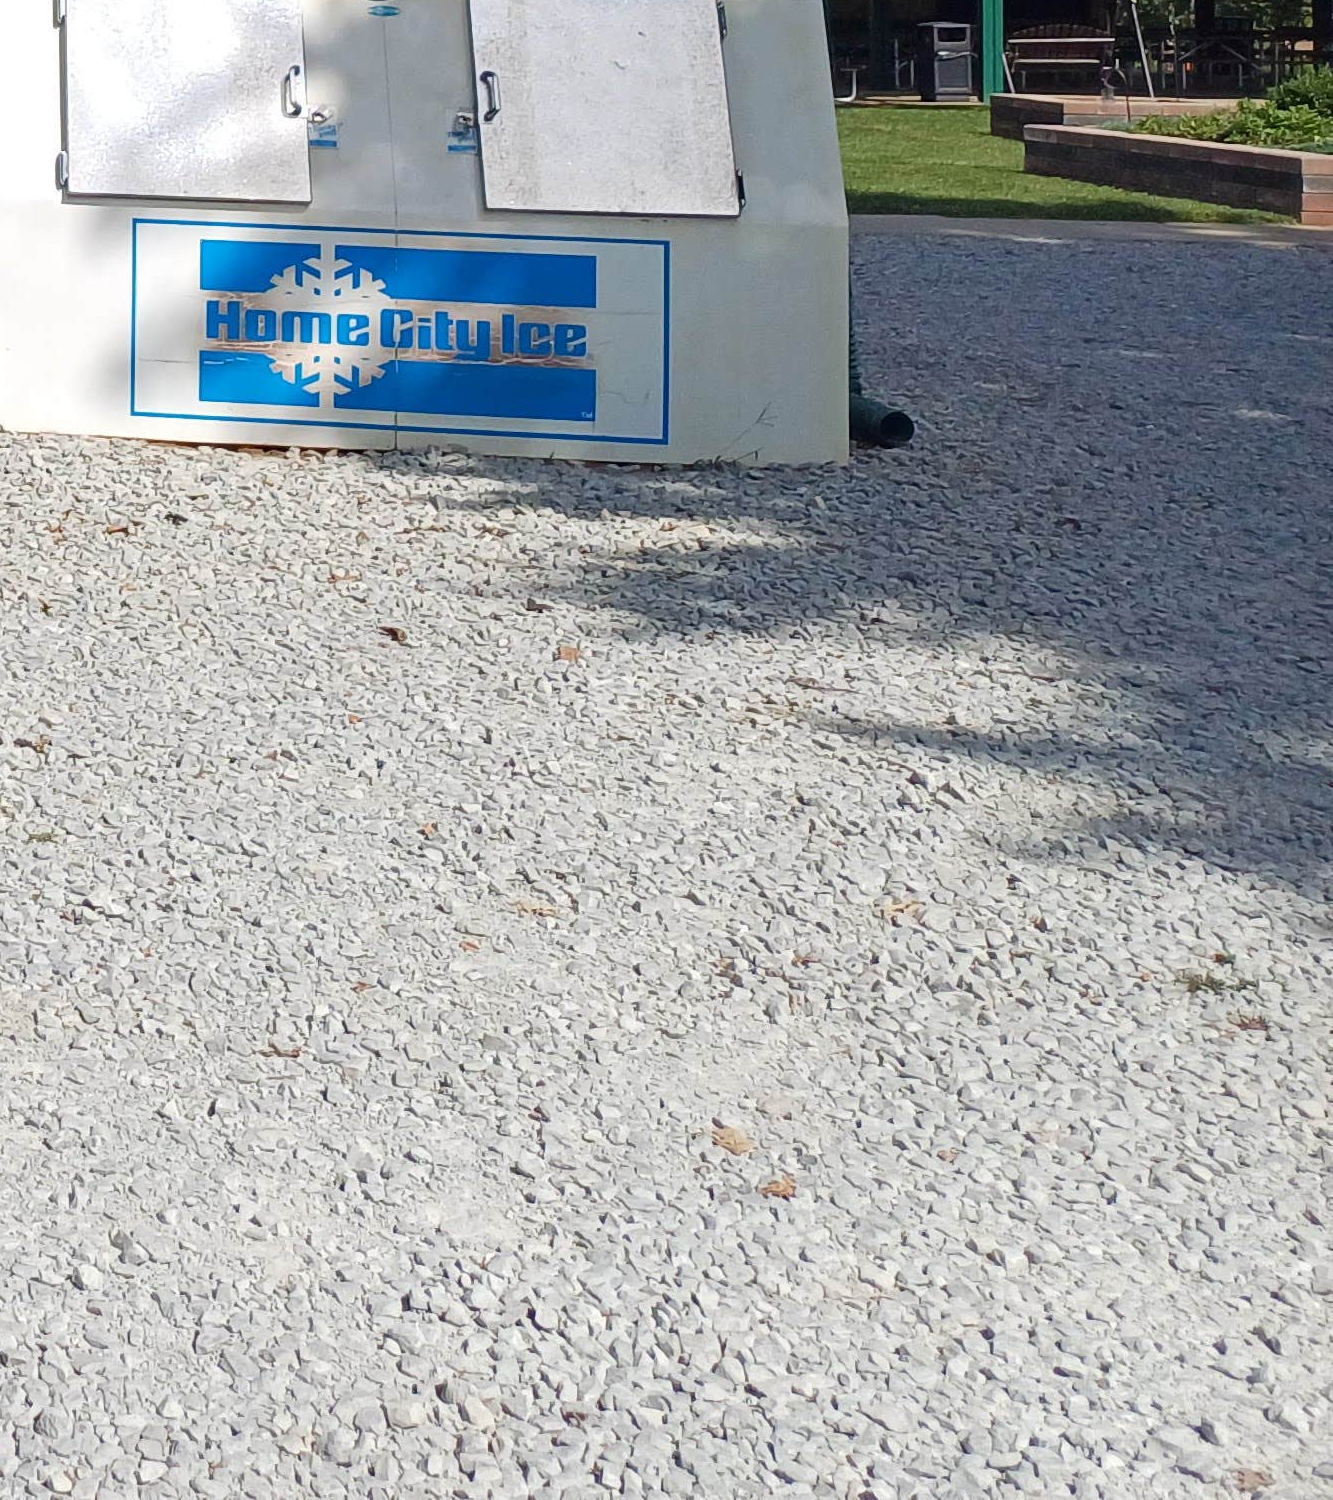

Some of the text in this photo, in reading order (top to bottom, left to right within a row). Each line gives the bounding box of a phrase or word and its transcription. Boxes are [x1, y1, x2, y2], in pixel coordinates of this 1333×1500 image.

[206, 300, 587, 361] Home City Ice
